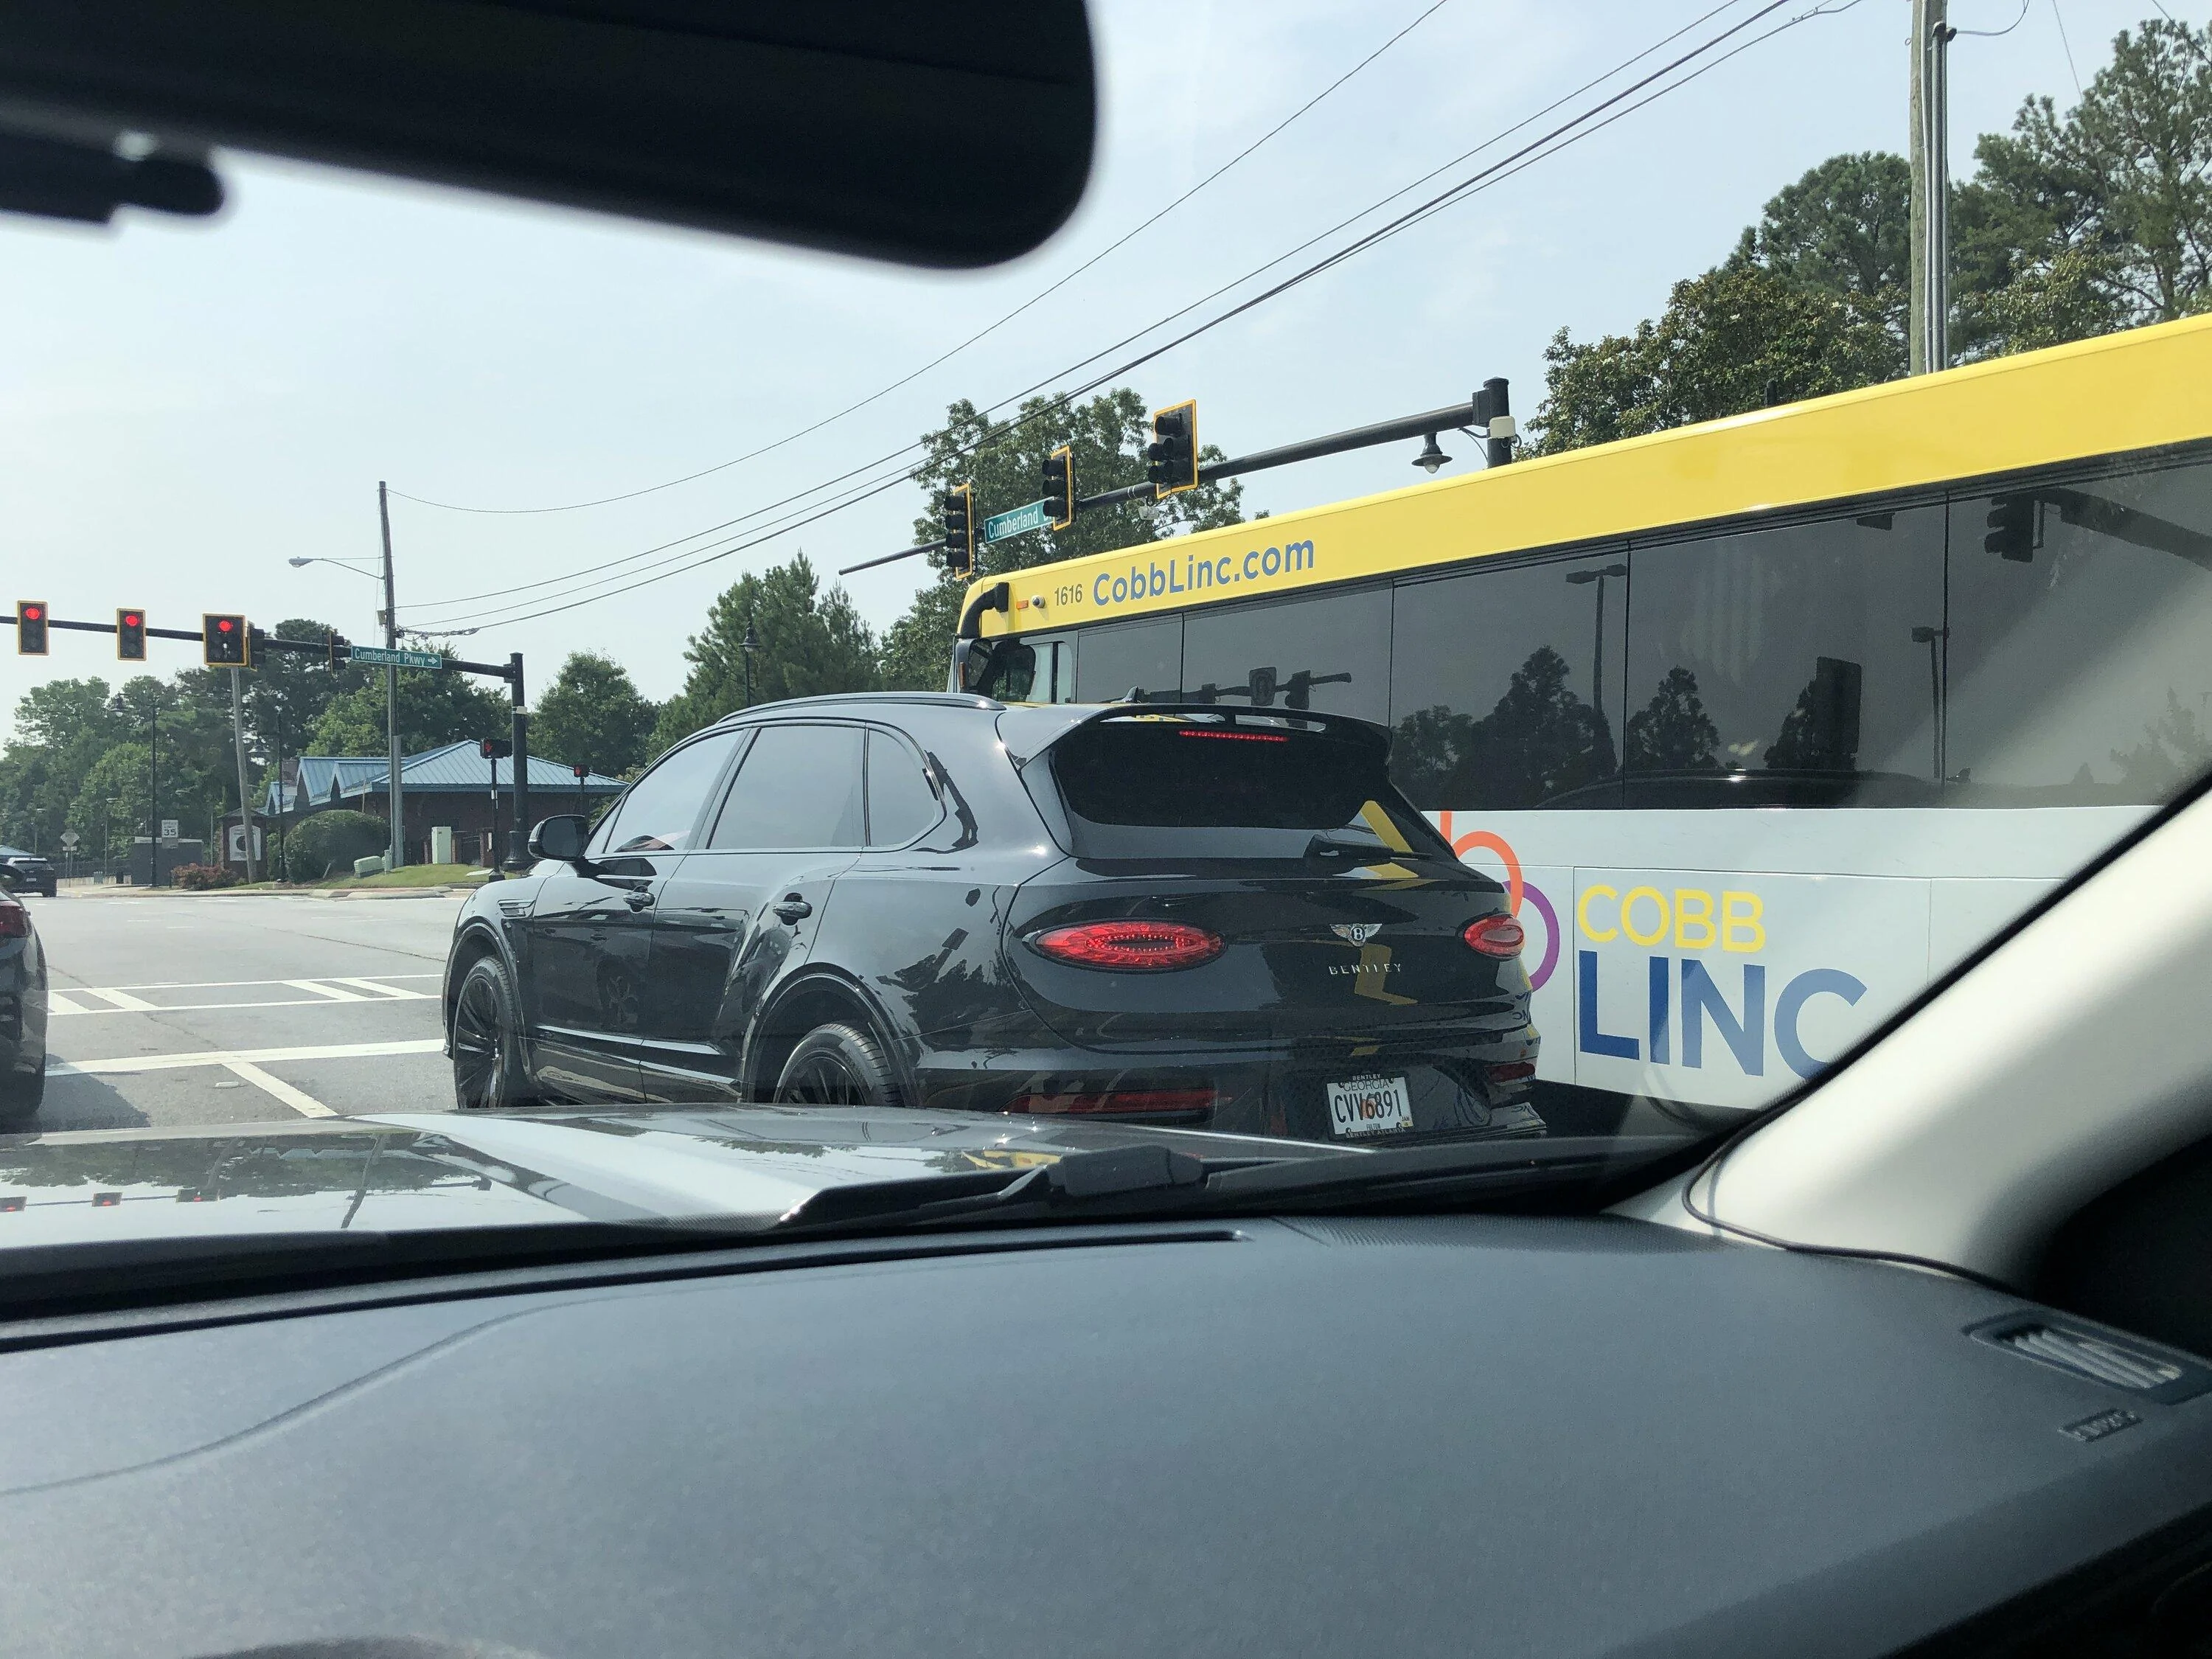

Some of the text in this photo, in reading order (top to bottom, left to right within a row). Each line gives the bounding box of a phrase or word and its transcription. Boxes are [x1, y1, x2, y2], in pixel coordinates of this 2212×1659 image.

[988, 507, 1038, 538] Cumberland
[1093, 540, 1314, 606] CobbLinc.com
[1054, 583, 1082, 606] 1616
[355, 648, 425, 667] Cumberland Pkwy
[1577, 884, 1767, 953] COBB
[1329, 963, 1401, 975] BENTLEY
[1579, 950, 1868, 1081] LINC
[1343, 1079, 1390, 1091] GEORGIA
[1335, 1089, 1402, 1123] CVV6891
[1377, 1127, 1405, 1135] ATLANTA
